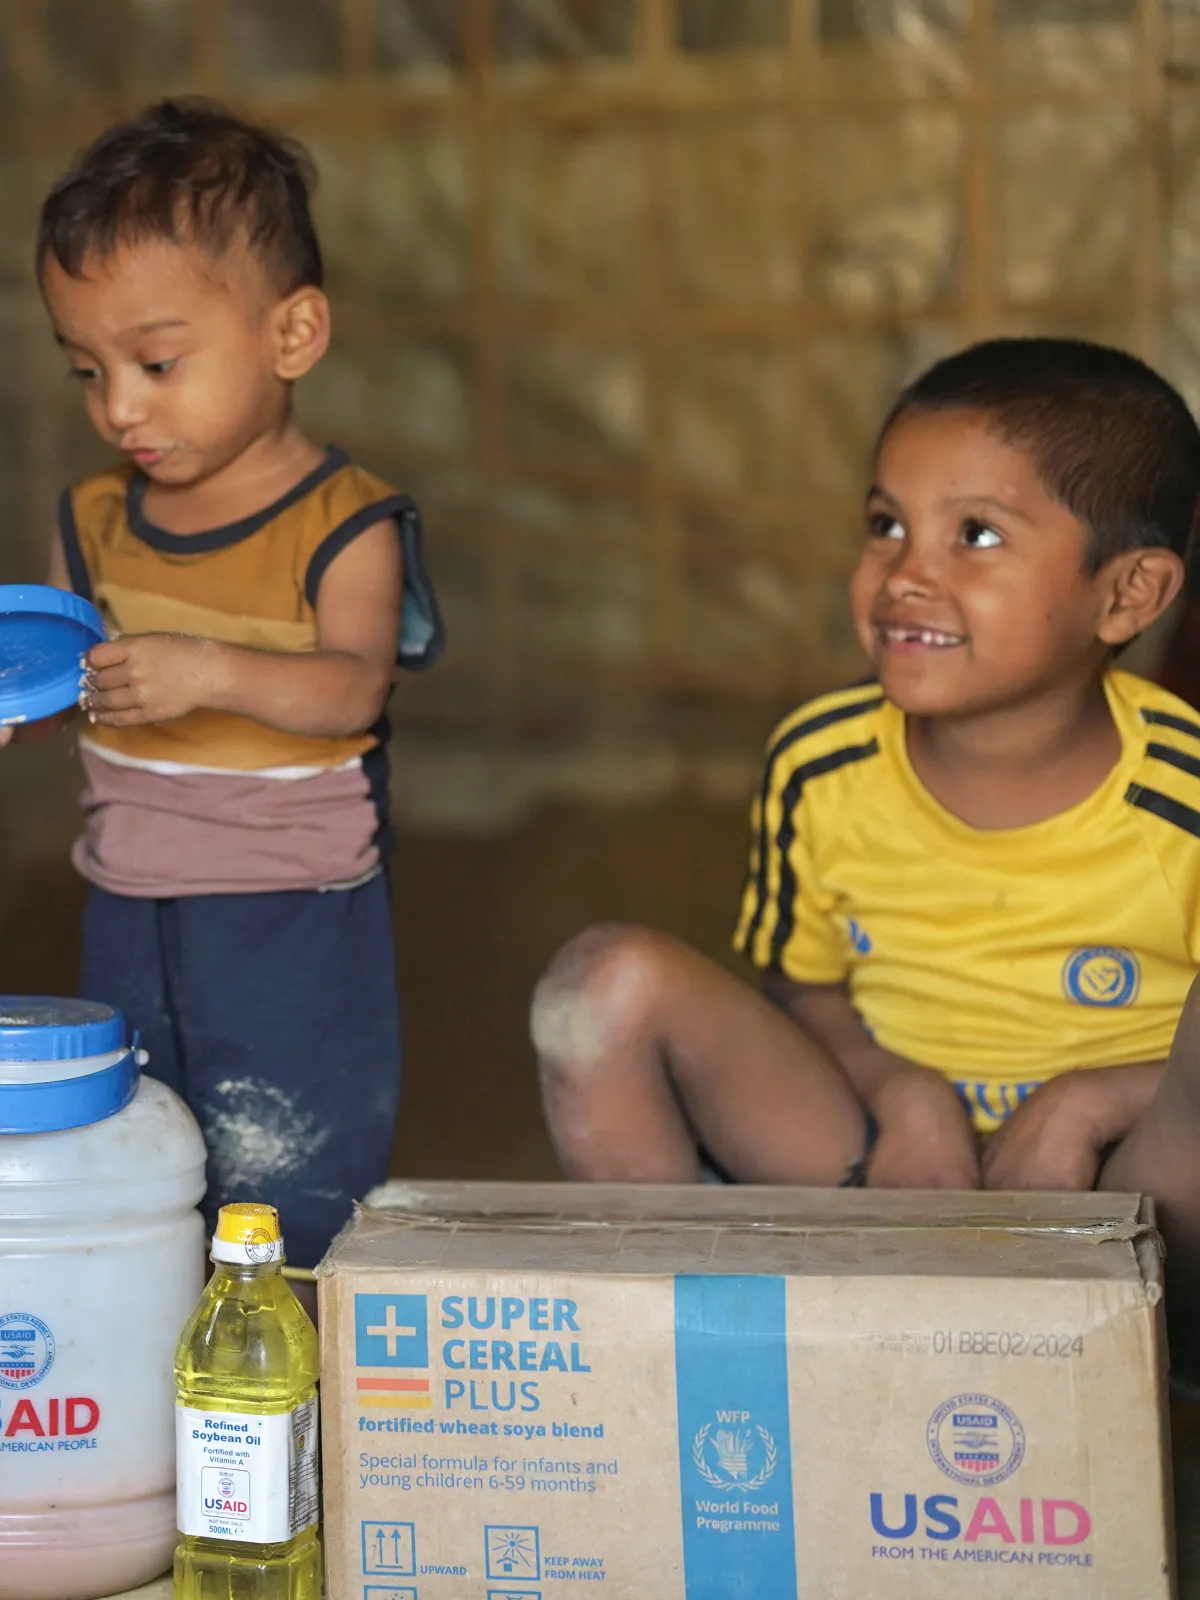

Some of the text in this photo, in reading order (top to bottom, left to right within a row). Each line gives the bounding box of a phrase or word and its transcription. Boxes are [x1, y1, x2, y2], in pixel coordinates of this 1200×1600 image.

[441, 1296, 581, 1331] SUPER
[30, 1318, 52, 1338] AGENCY
[442, 1339, 592, 1373] CEREAL
[20, 1351, 53, 1388] DEVELOPMENT
[444, 1379, 540, 1412] PLUS
[716, 1410, 750, 1423] WFP
[956, 1415, 993, 1426] USAID
[204, 1419, 248, 1432] Refined
[358, 1416, 604, 1440] fortified wheat soya blend
[58, 1439, 97, 1451] PEOPLE
[192, 1430, 261, 1446] Soybean Oil
[203, 1447, 250, 1458] Fortified with
[209, 1456, 236, 1465] Vitamin
[359, 1453, 618, 1475] Special formula for infants and
[359, 1472, 596, 1492] young children 6-59 months
[205, 1498, 247, 1512] USAID
[695, 1500, 779, 1515] World Food
[696, 1516, 780, 1533] Programme
[870, 1492, 1092, 1546] USAID
[209, 1525, 233, 1535] 500ML
[544, 1556, 604, 1568] KEEP AWAY
[871, 1545, 1094, 1567] FROM THE AMERICAN PEOPLE
[420, 1565, 467, 1576] UPWARD
[544, 1569, 606, 1581] FROM HEAT
